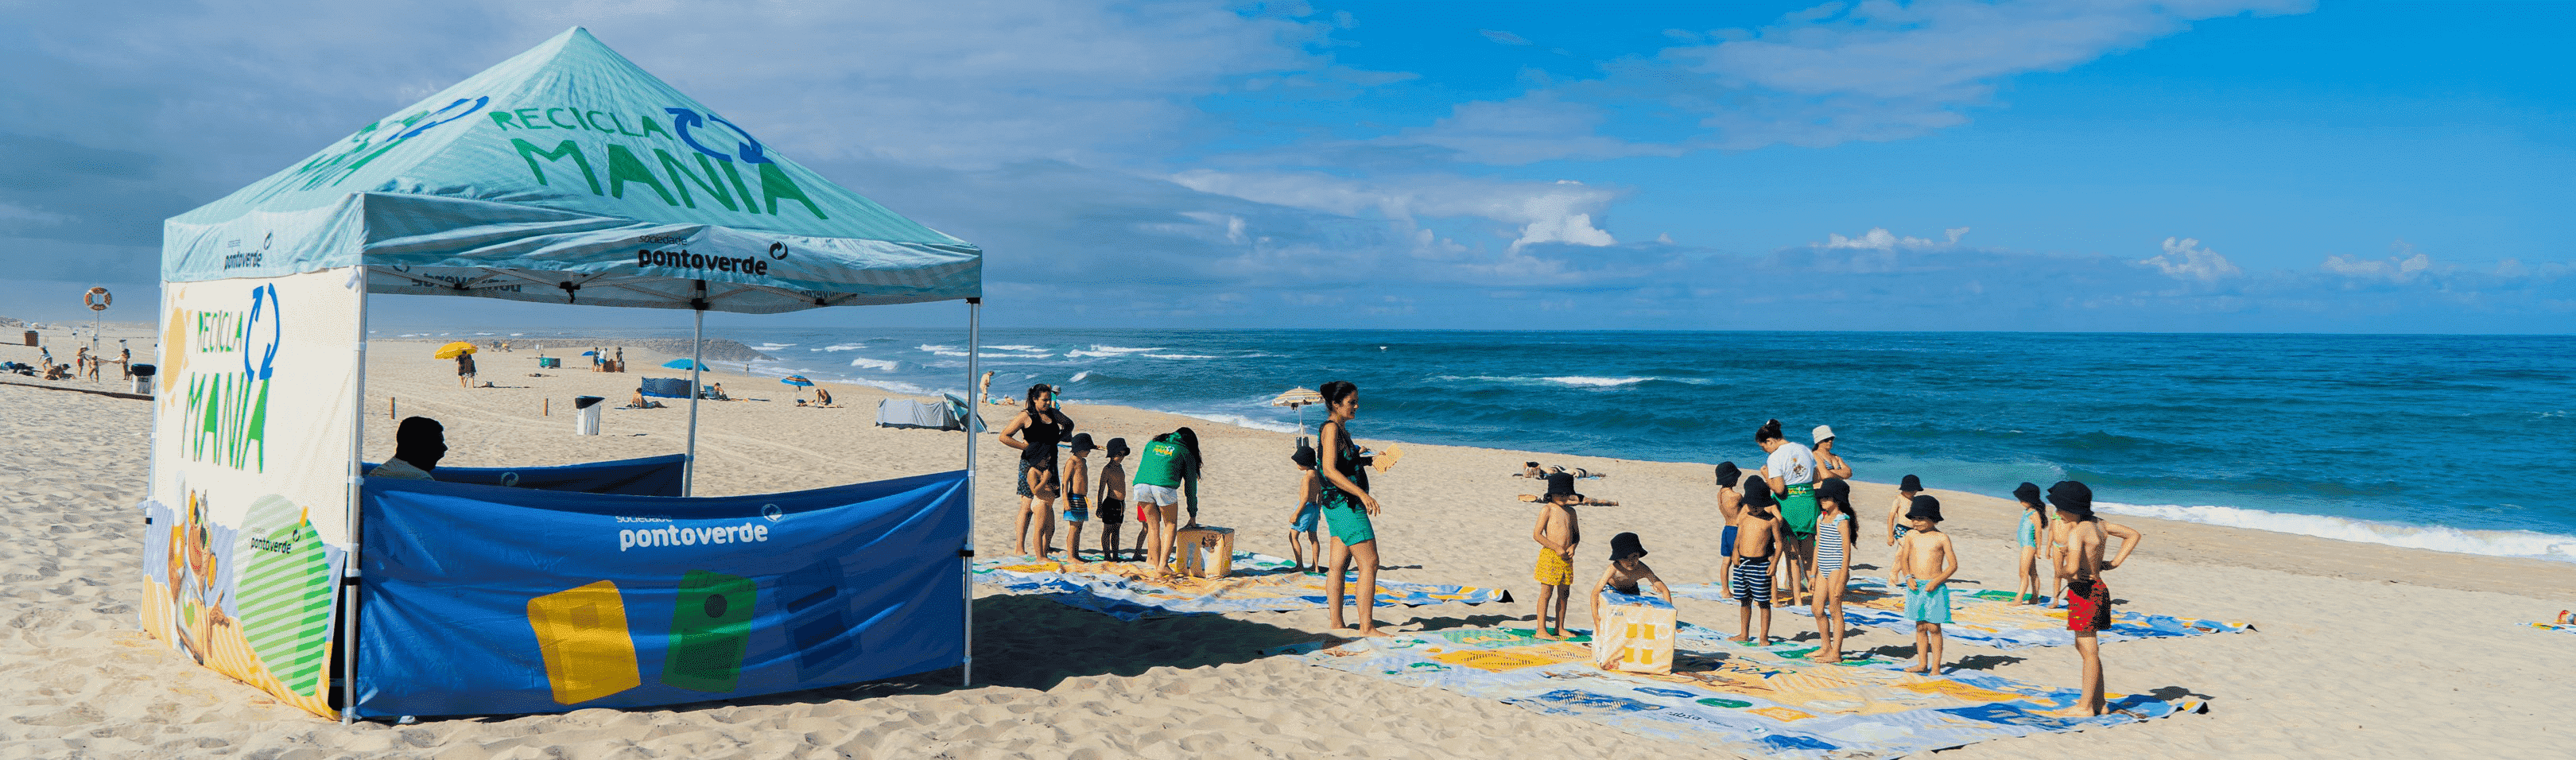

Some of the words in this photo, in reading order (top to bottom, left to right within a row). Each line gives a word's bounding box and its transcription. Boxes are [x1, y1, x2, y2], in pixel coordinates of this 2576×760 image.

[488, 107, 673, 140] RECICLA
[510, 138, 828, 220] MANIA
[638, 235, 688, 246] sociedade
[638, 249, 768, 276] pontoverde
[196, 310, 243, 354] RECICLA
[180, 371, 270, 475] MANIA
[250, 537, 292, 555] pontoverde
[619, 522, 769, 553] pontoverde
